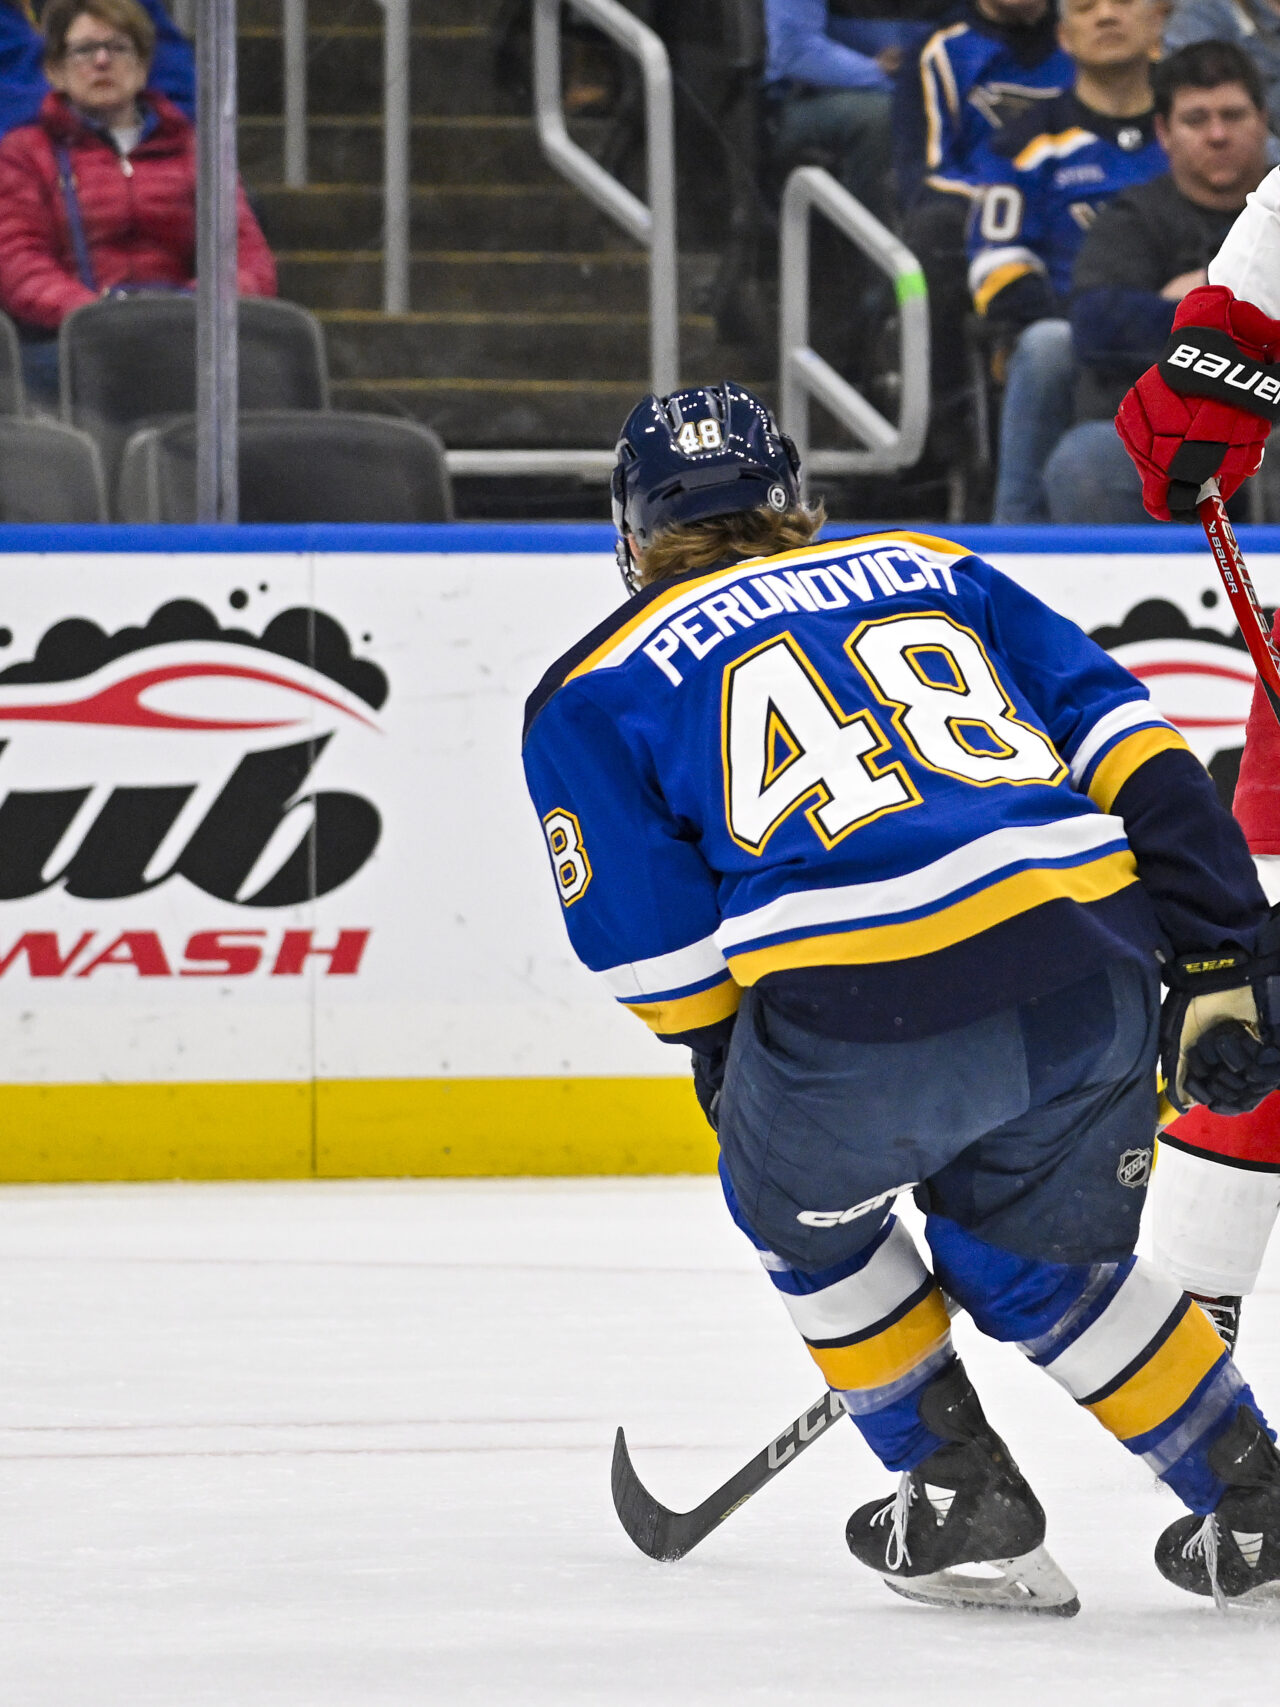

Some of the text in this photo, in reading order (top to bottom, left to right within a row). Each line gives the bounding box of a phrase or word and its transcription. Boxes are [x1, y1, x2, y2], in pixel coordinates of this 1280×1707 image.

[678, 421, 722, 453] 48
[643, 549, 958, 688] PERUNOVICH
[1211, 535, 1239, 595] BAUER
[721, 610, 1070, 858] 48
[0, 730, 383, 908] ub
[542, 806, 593, 908] 8
